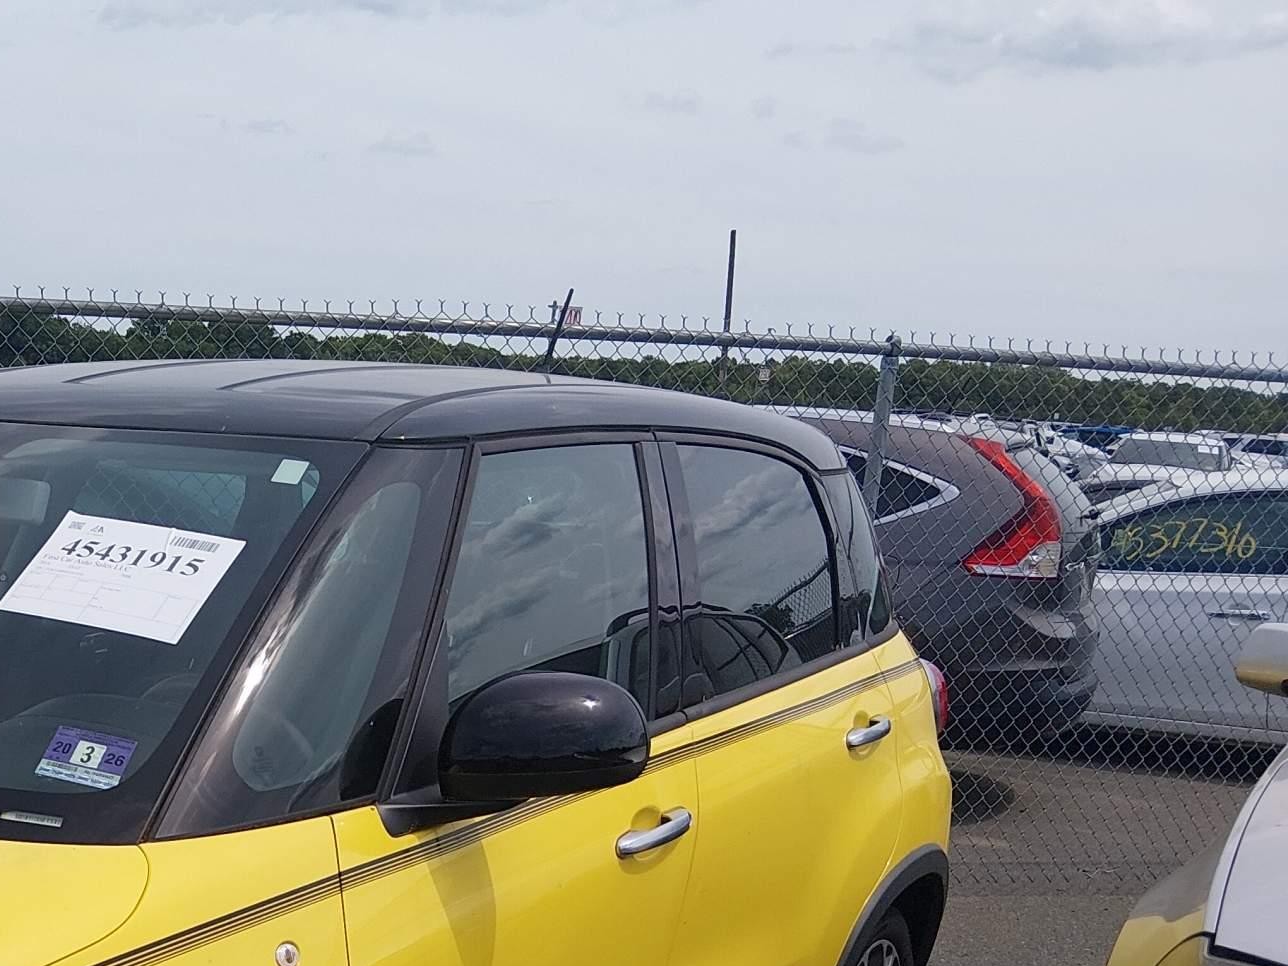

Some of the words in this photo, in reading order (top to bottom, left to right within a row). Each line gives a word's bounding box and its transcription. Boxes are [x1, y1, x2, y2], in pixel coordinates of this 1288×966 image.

[60, 538, 205, 577] 45431915
[52, 740, 72, 755] 20
[79, 745, 96, 764] 3
[103, 752, 126, 767] 26
